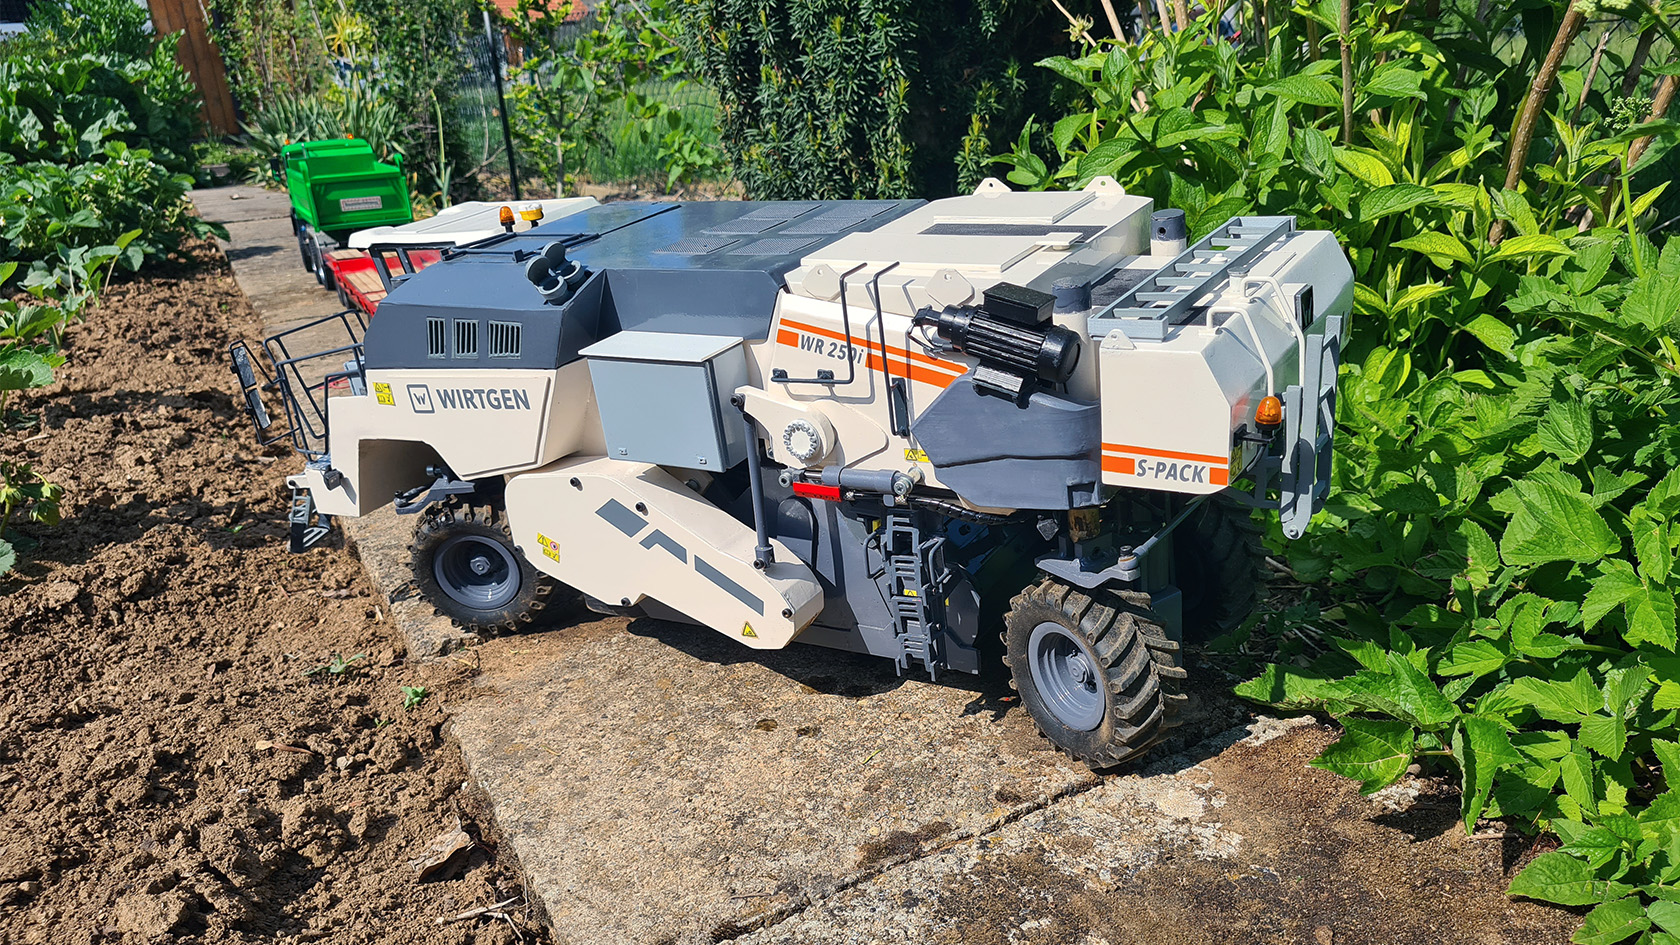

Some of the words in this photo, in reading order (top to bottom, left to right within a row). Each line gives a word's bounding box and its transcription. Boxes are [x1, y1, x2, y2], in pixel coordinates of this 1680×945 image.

[800, 334, 824, 355] WR
[413, 393, 426, 405] W
[436, 388, 531, 410] WIRTGEN
[1136, 459, 1206, 483] S-PACK
